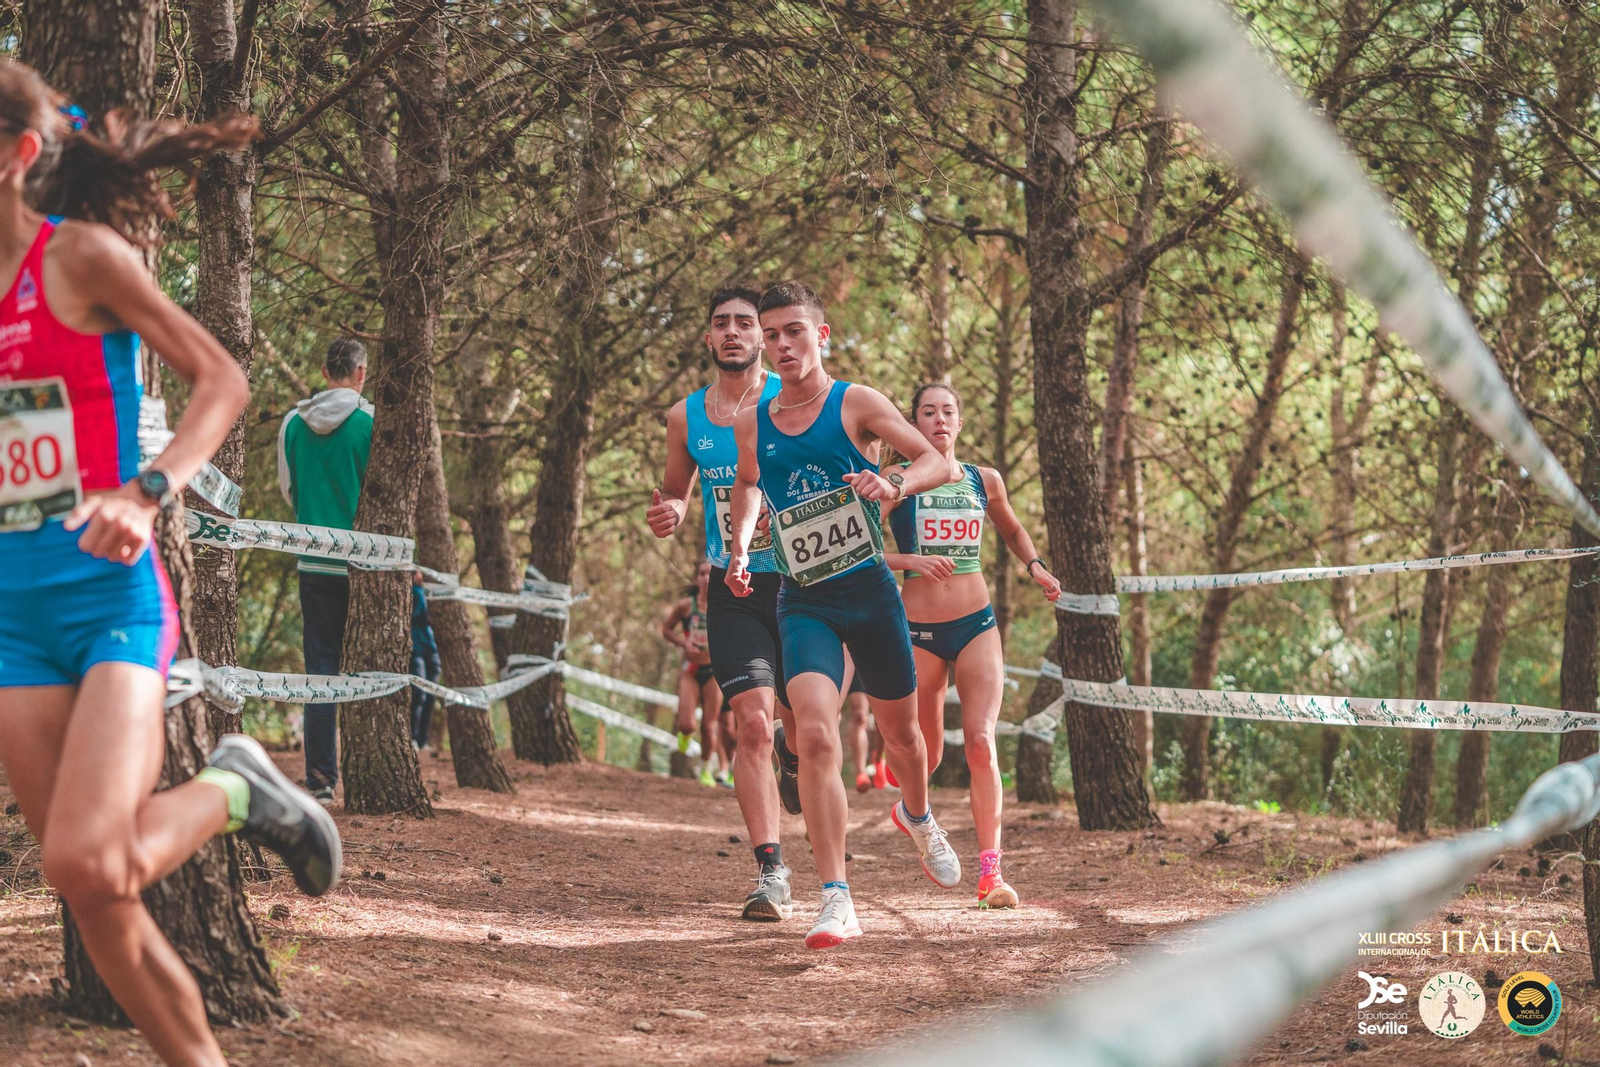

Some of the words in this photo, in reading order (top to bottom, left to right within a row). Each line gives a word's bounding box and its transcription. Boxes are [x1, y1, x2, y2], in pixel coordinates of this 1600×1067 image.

[806, 463, 831, 488] ORIPPO
[786, 488, 800, 498] DOS
[795, 497, 835, 518] ITÁLICA
[791, 515, 863, 564] 8244
[923, 519, 980, 540] 5590
